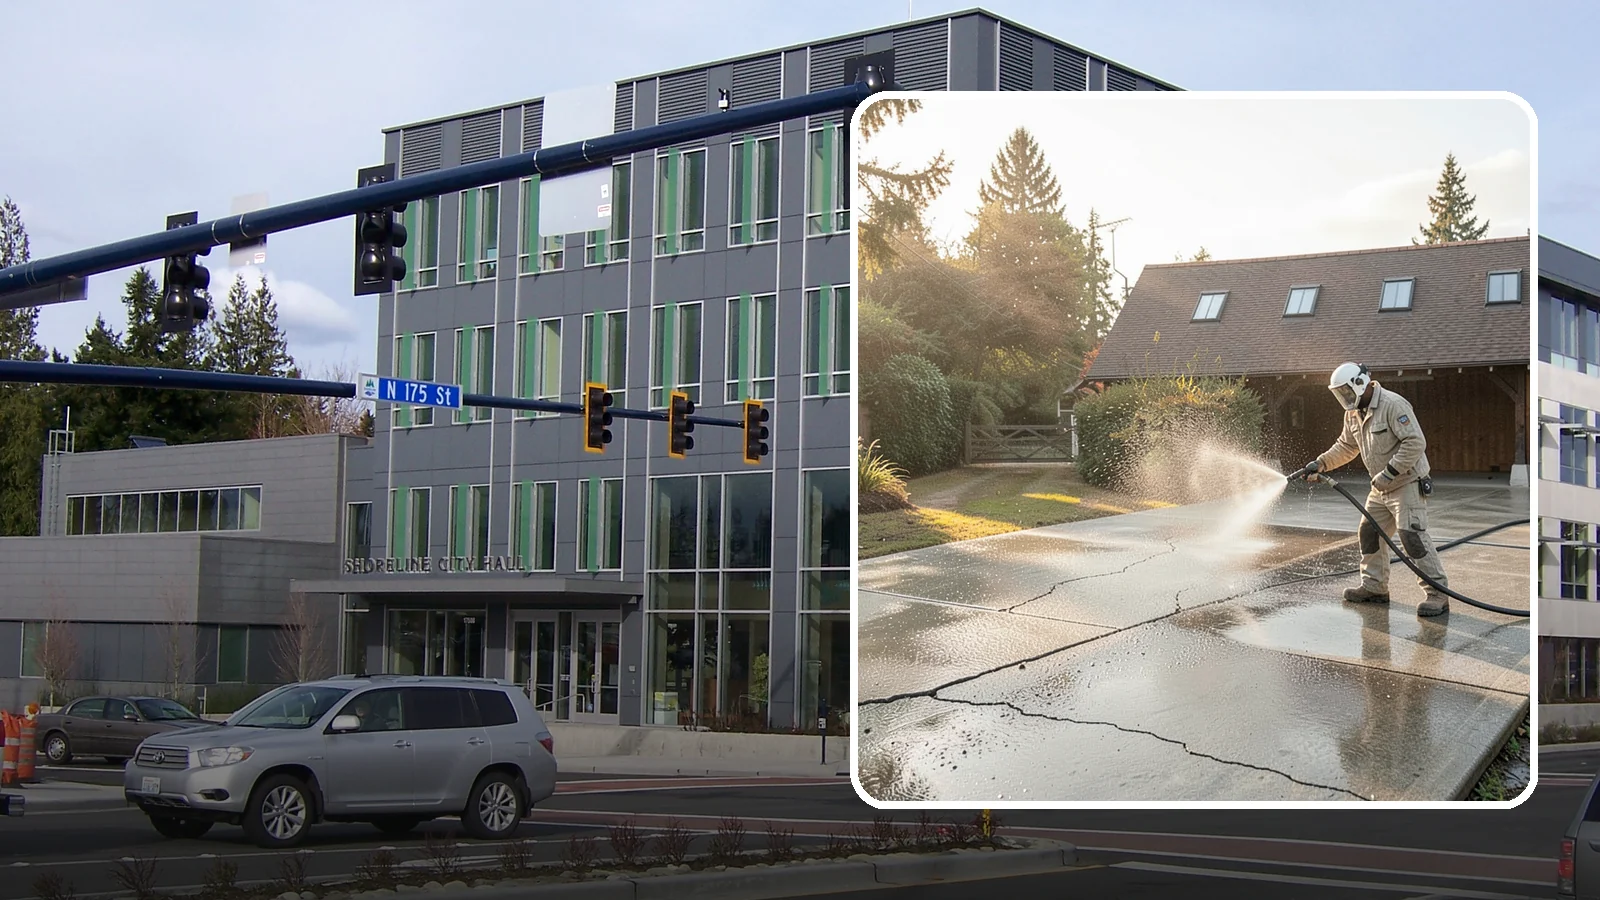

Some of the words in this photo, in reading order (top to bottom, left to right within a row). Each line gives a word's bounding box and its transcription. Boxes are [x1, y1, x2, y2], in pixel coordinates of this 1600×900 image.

[387, 380, 396, 399] N
[405, 382, 427, 403] 175
[436, 386, 451, 406] St
[344, 557, 432, 574] SHORELINE
[438, 556, 475, 572] CITY
[483, 556, 525, 572] HALL
